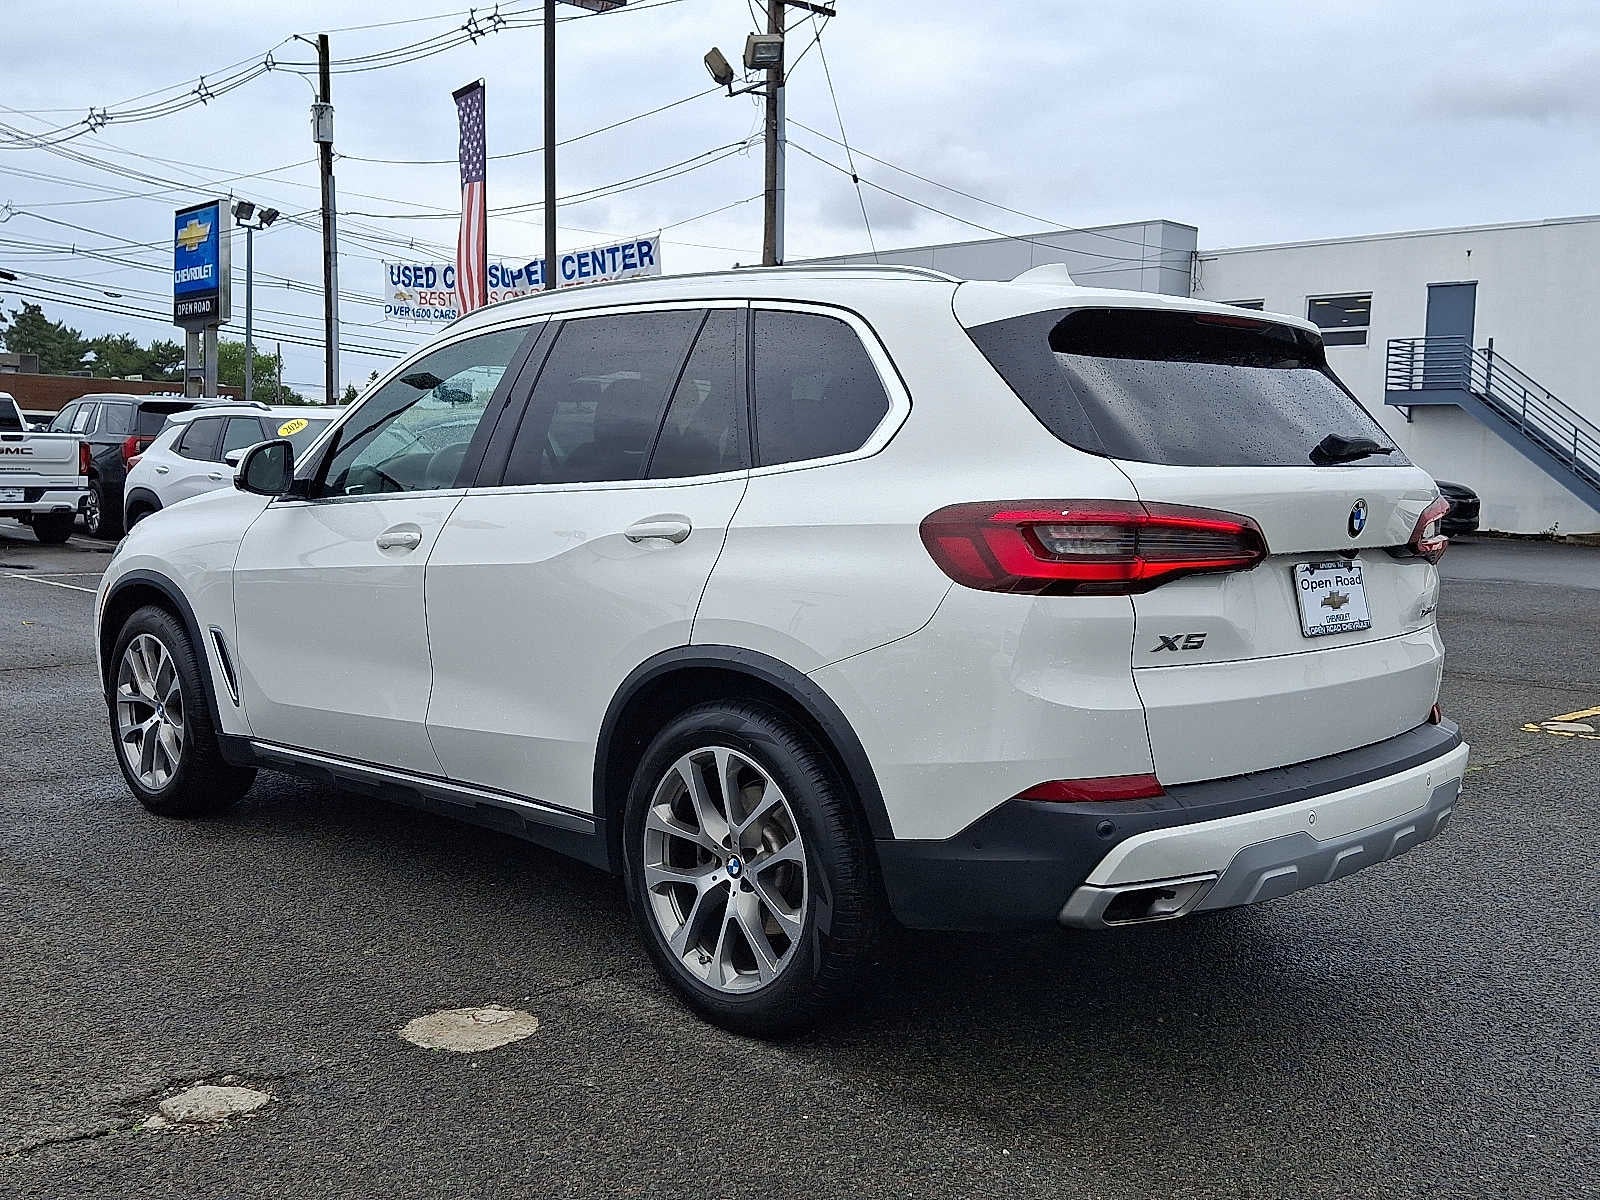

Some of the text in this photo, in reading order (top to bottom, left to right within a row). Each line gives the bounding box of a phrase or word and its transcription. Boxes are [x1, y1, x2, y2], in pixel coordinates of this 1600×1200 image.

[389, 264, 437, 289] USED
[561, 240, 654, 281] CENTER
[174, 263, 213, 284] CHEVROLET
[418, 291, 457, 307] BEST
[177, 300, 211, 316] OPEN ROAD
[384, 304, 457, 320] OVER 1500 CARS
[1301, 574, 1362, 592] Open Road
[1325, 623, 1342, 633] ROAD
[1150, 633, 1207, 653] X5
